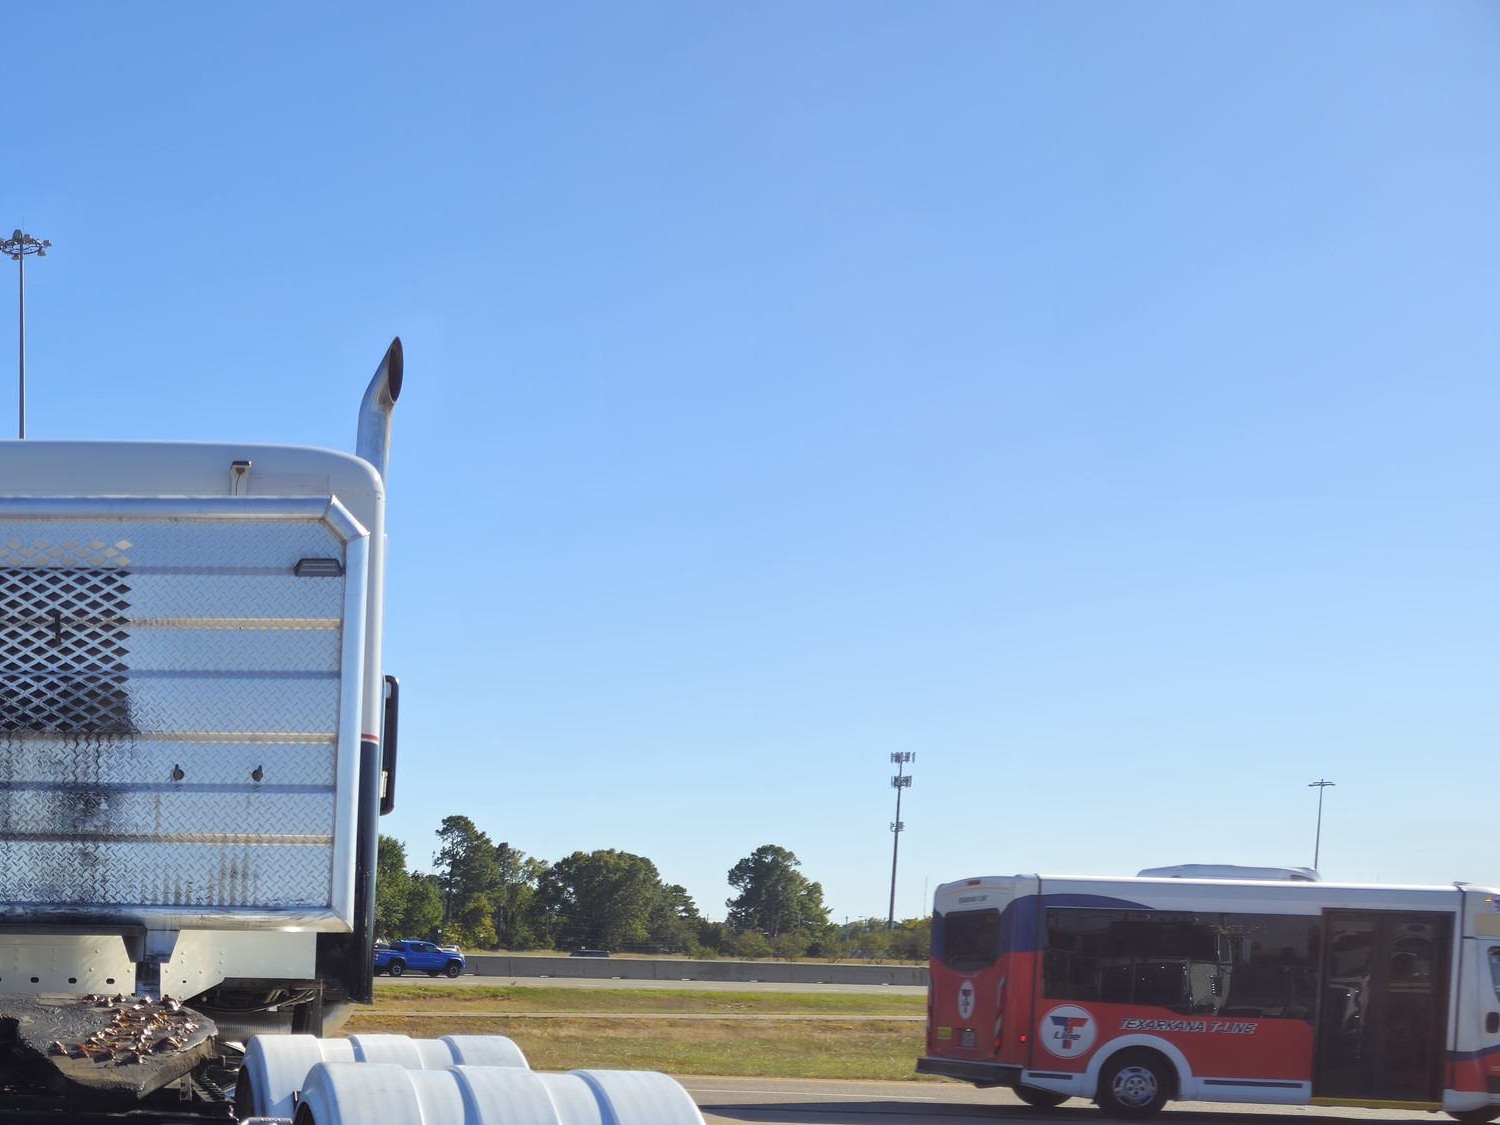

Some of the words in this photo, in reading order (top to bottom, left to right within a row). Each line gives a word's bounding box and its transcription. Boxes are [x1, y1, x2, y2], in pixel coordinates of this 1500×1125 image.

[1119, 1018, 1206, 1033] TEXARKANA
[1209, 1022, 1258, 1034] T-LINE
[1053, 1031, 1081, 1041] Line
